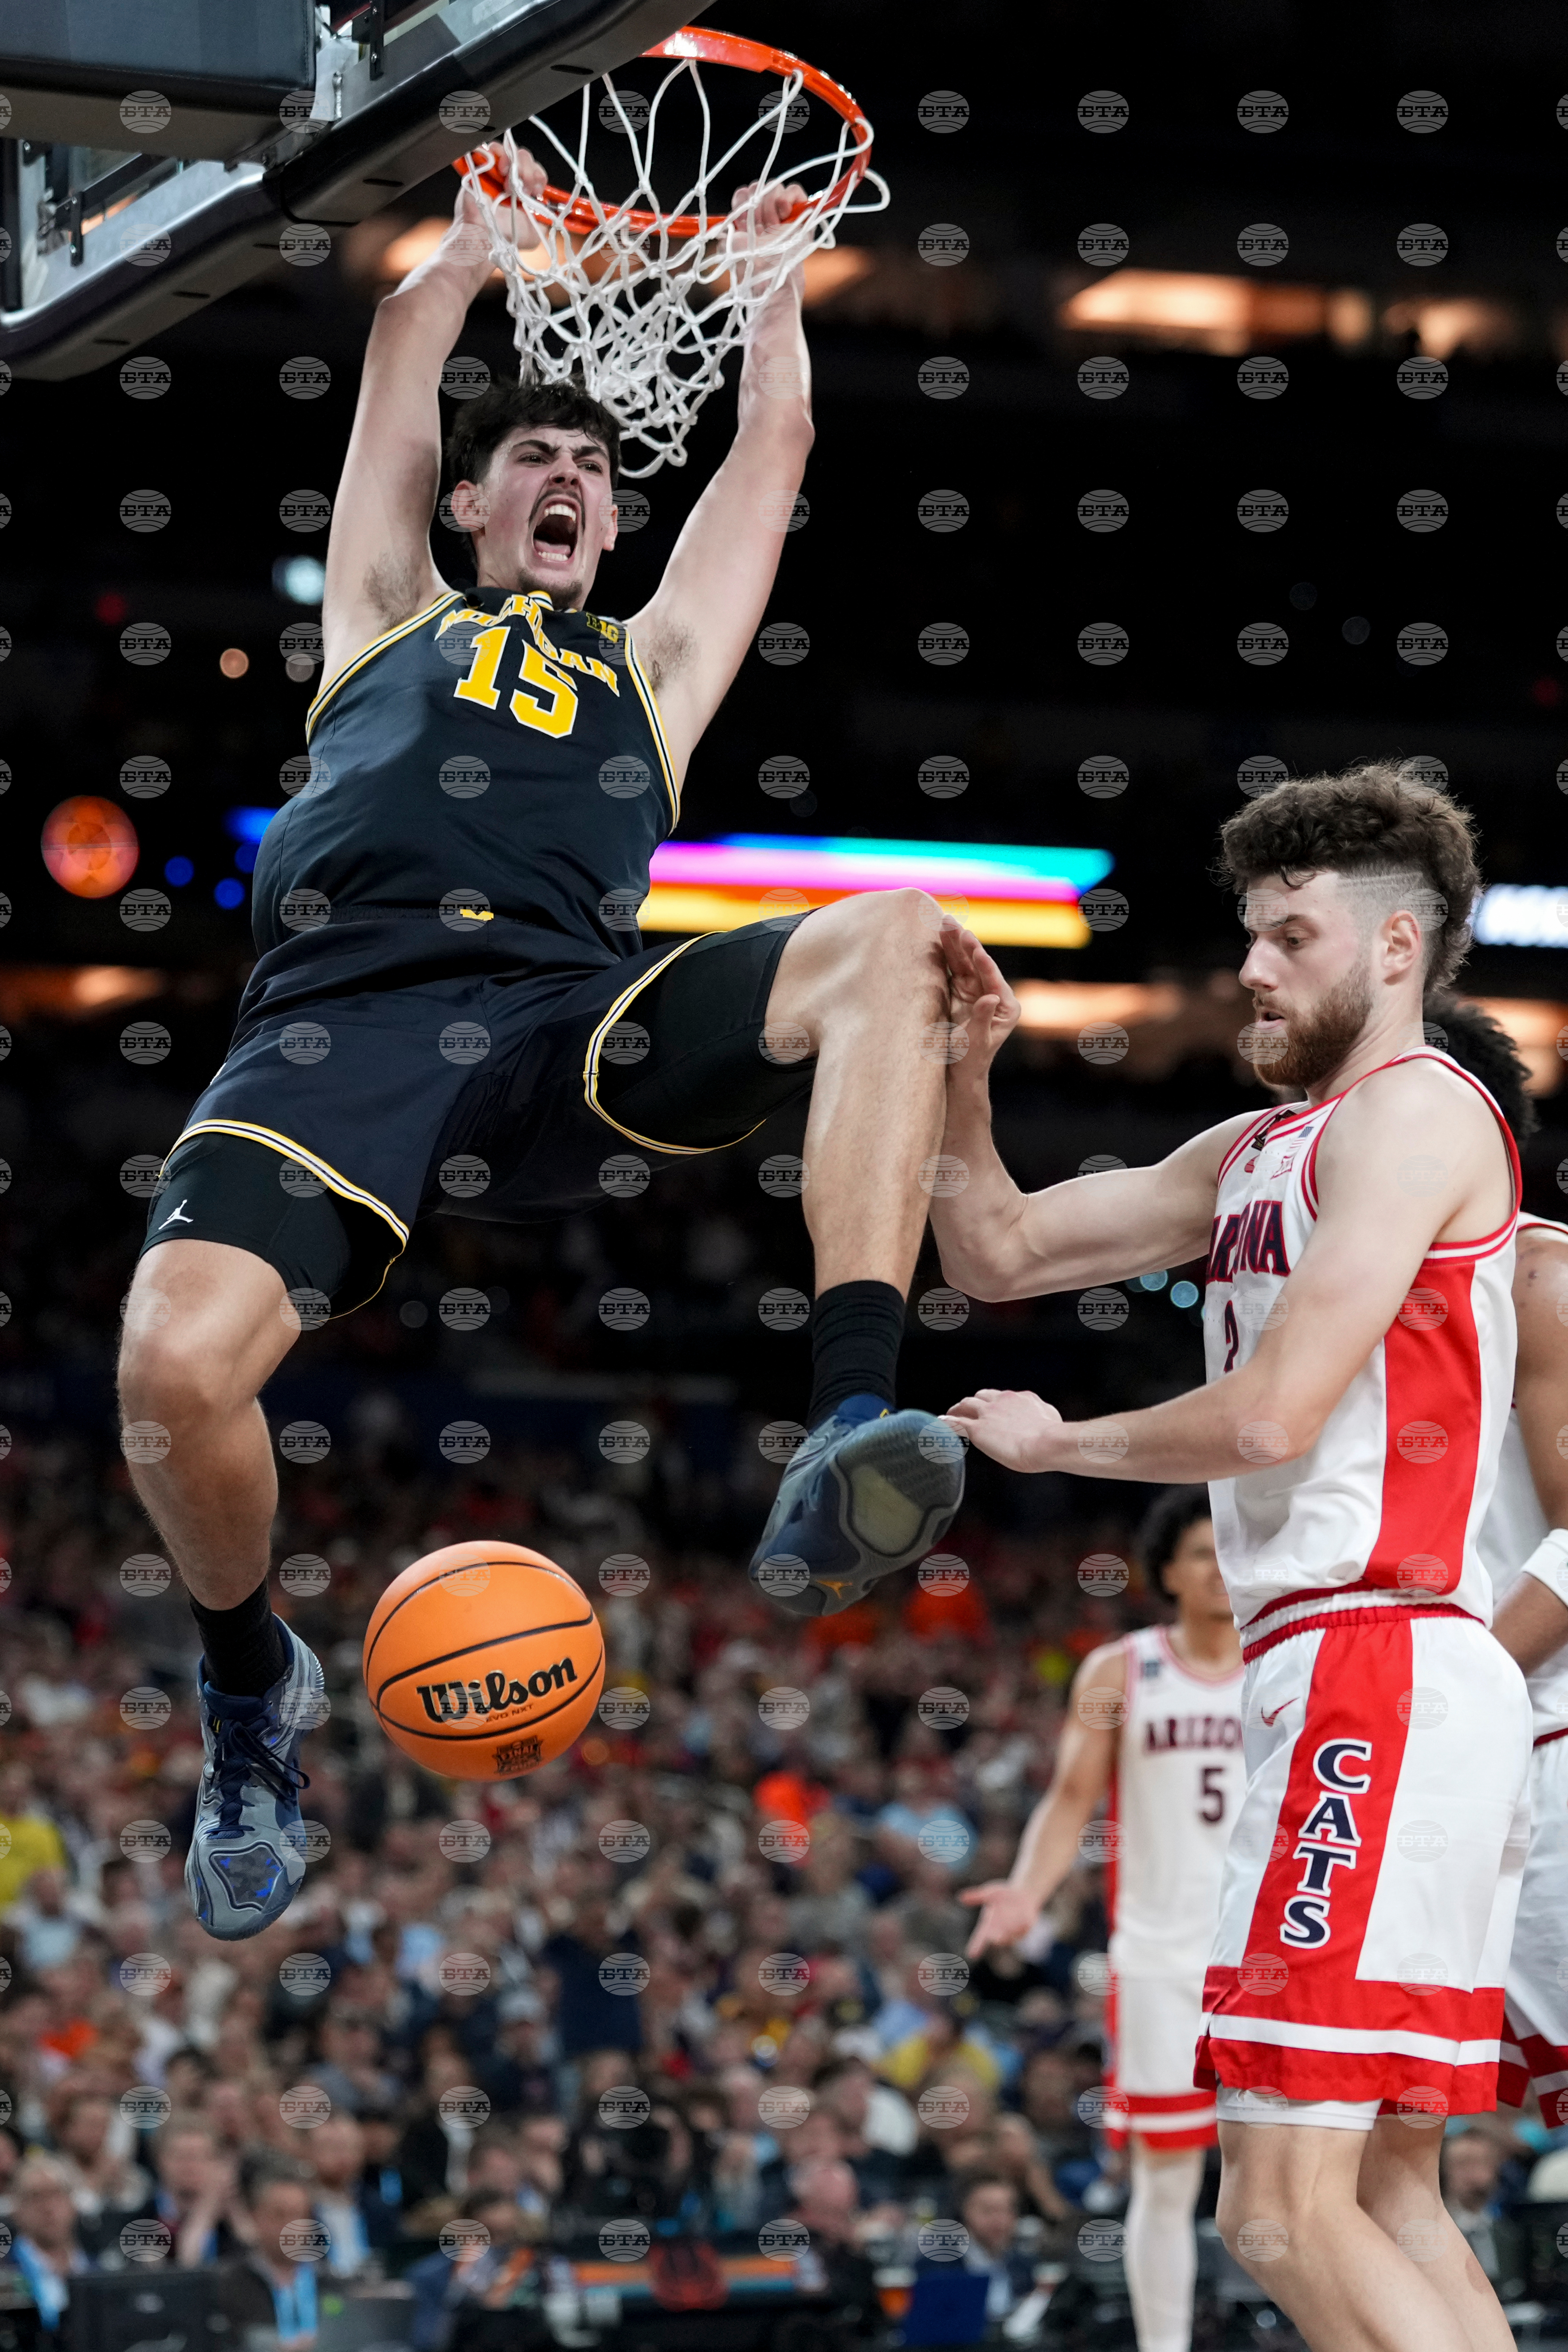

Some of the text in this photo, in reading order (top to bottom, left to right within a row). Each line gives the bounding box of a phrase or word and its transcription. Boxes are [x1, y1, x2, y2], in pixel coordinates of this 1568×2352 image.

[453, 626, 578, 738] 15
[416, 1657, 577, 1724] Wilson
[1199, 1766, 1226, 1825] 5
[1280, 1738, 1372, 1949] CATS
